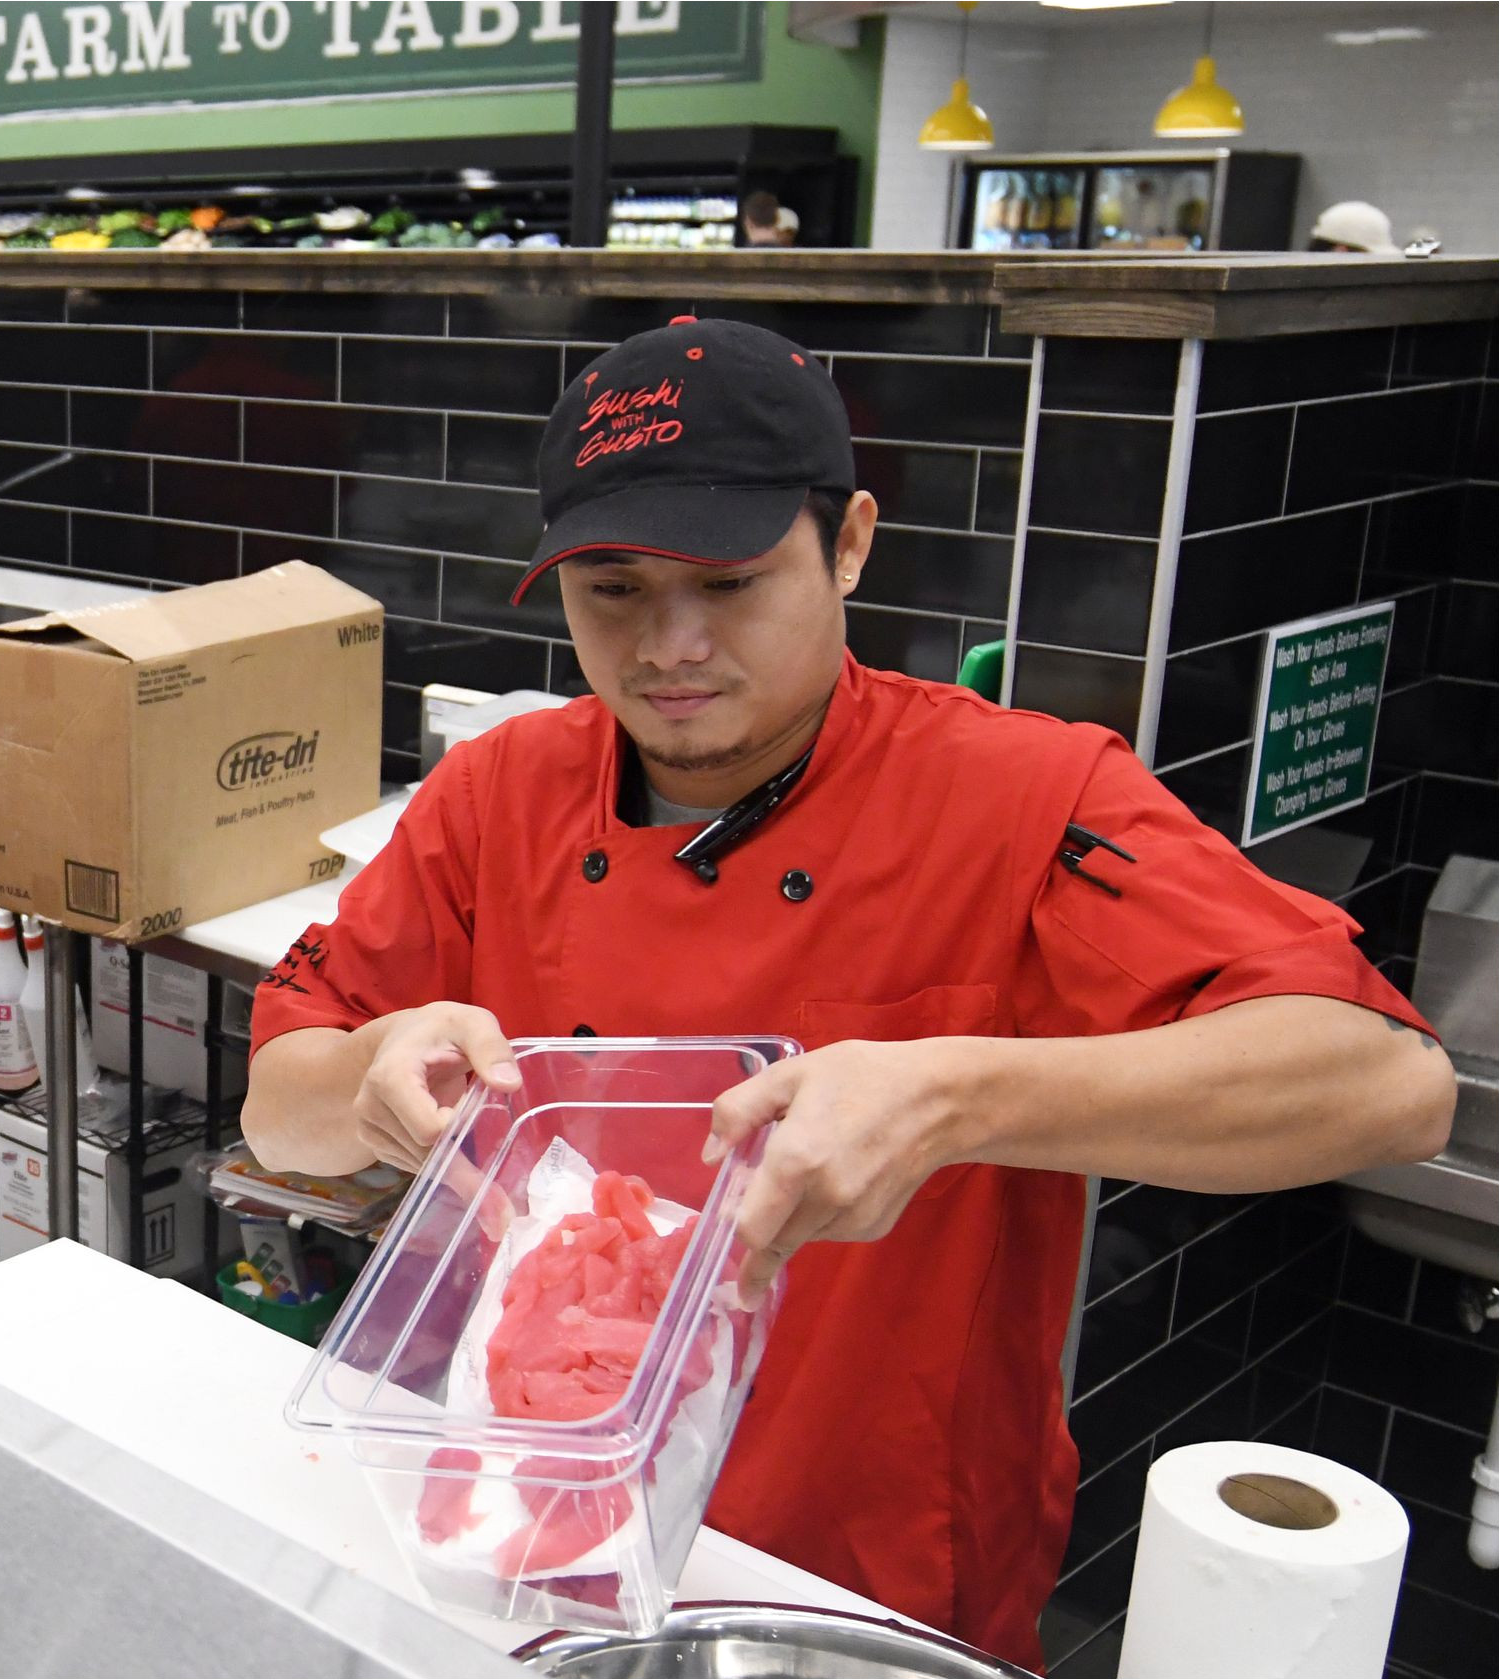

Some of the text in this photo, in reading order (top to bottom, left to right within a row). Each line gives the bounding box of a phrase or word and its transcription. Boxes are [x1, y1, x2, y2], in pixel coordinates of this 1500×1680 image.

[212, 1, 291, 53] TO
[611, 412, 645, 430] WITH
[576, 416, 683, 467] Gusto
[337, 622, 380, 648] White
[1276, 624, 1388, 669] Wash Your Hands Before Entering
[1309, 660, 1347, 687] Sushi Area
[1269, 684, 1377, 733] Wash Your Hands Before Putting
[1293, 720, 1345, 752] On Your Gloves
[228, 729, 320, 786] tite-dri
[1266, 769, 1285, 794] Wash
[1287, 766, 1302, 786] Your
[1303, 757, 1325, 780] Hands
[241, 806, 258, 821] Fish
[259, 804, 266, 815] &
[1275, 777, 1347, 817] Changing Your Gloves
[141, 907, 182, 937] 2000
